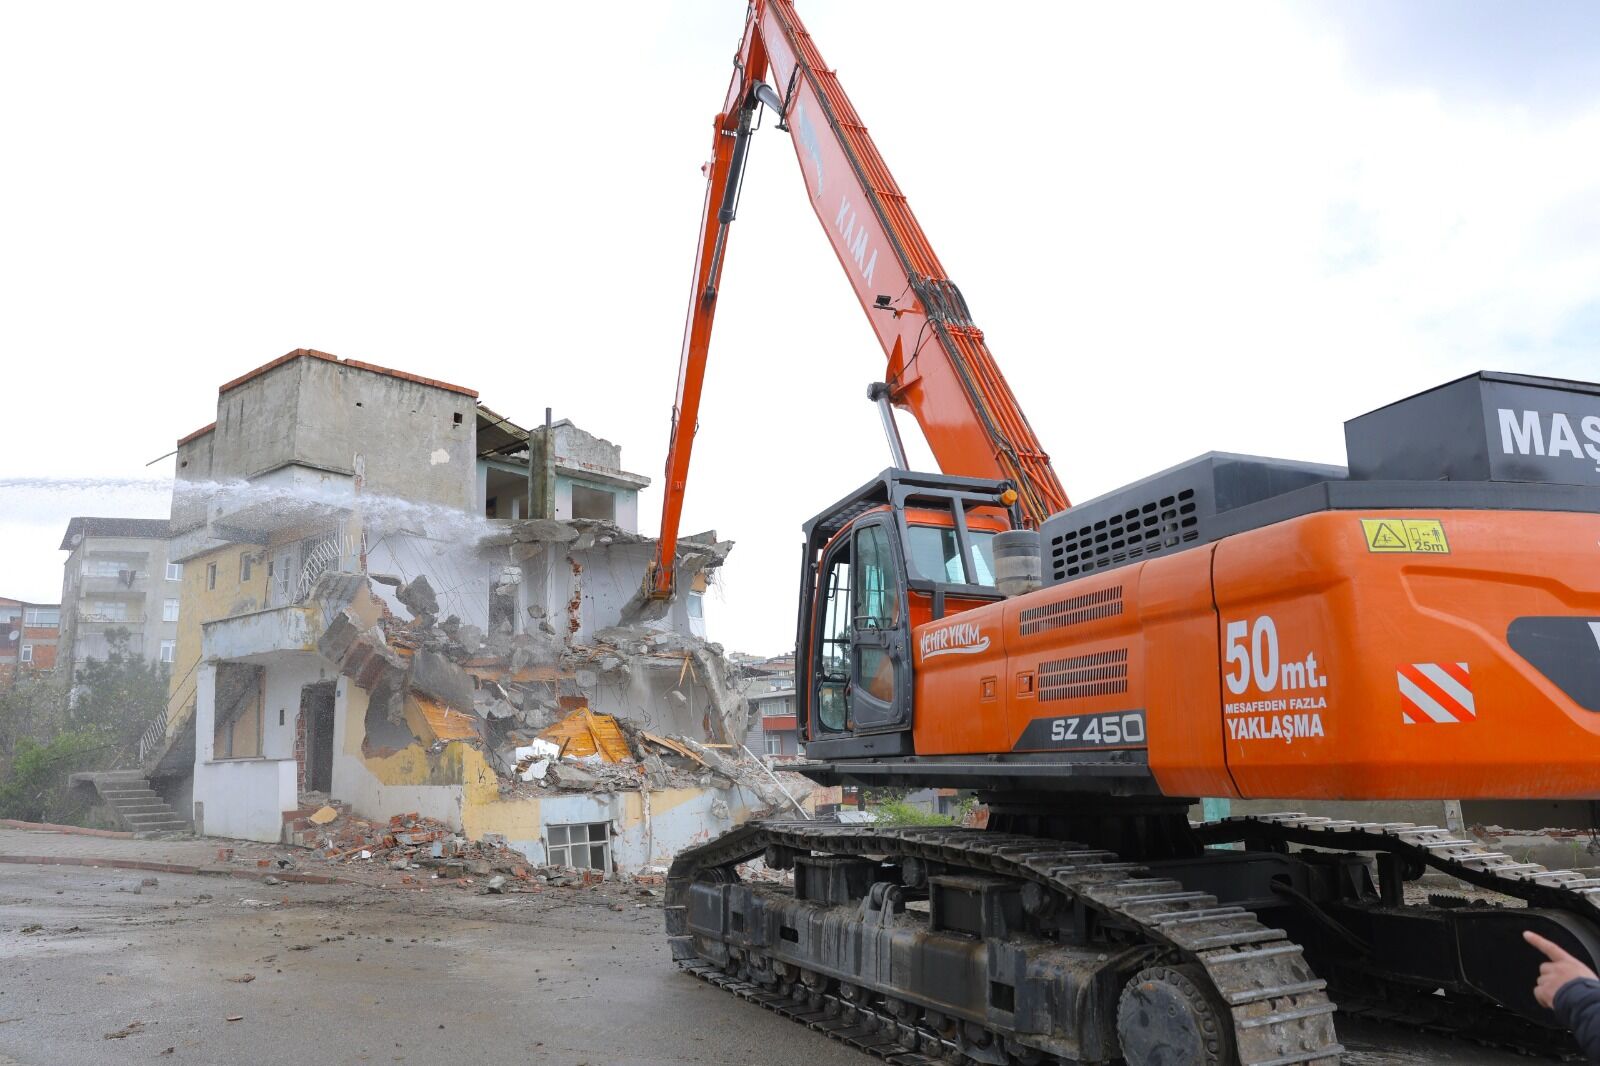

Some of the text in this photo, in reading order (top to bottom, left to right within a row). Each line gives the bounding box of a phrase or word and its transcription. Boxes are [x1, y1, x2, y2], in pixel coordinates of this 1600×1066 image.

[1414, 541, 1444, 552] 25m
[1225, 697, 1327, 714] MESAFEDEN FAZLA
[1226, 713, 1325, 744] YAKLAŞMA
